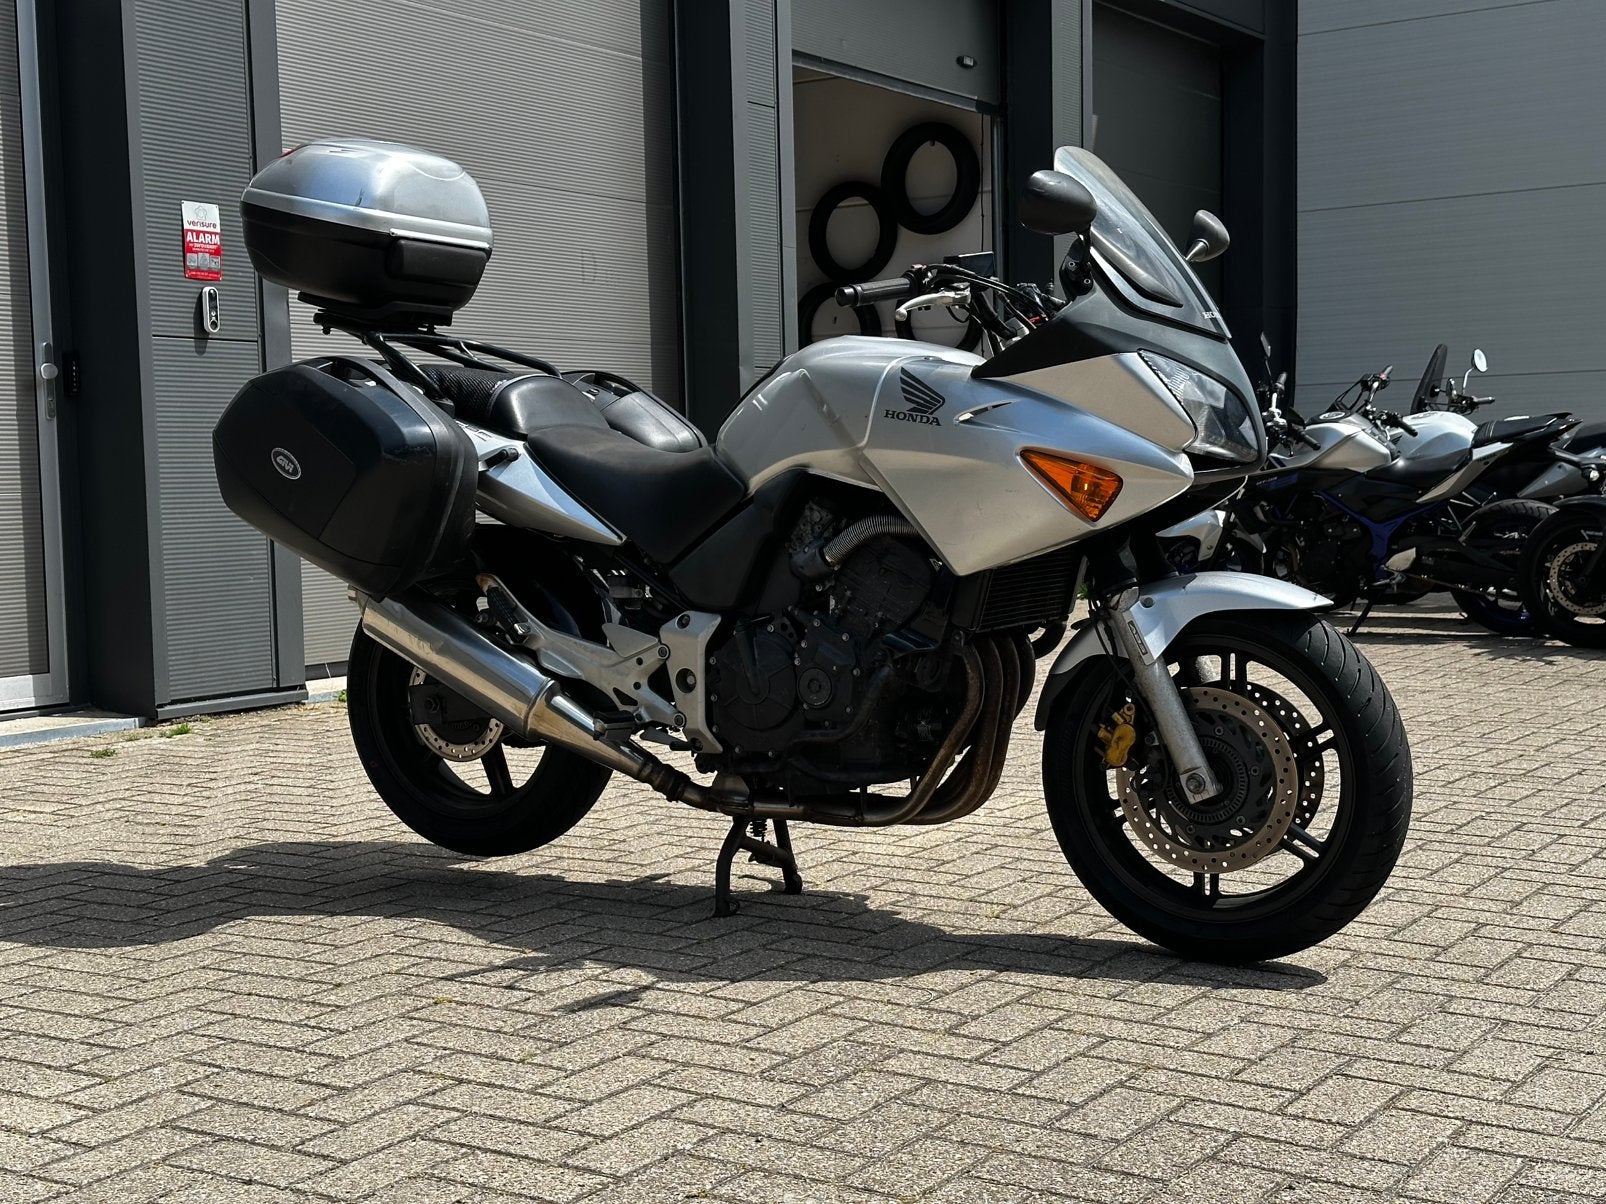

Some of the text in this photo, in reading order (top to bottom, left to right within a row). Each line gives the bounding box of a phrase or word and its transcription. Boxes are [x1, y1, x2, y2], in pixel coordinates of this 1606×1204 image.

[187, 220, 217, 229] verisure
[186, 231, 220, 245] ALARM
[884, 409, 942, 426] HONDA
